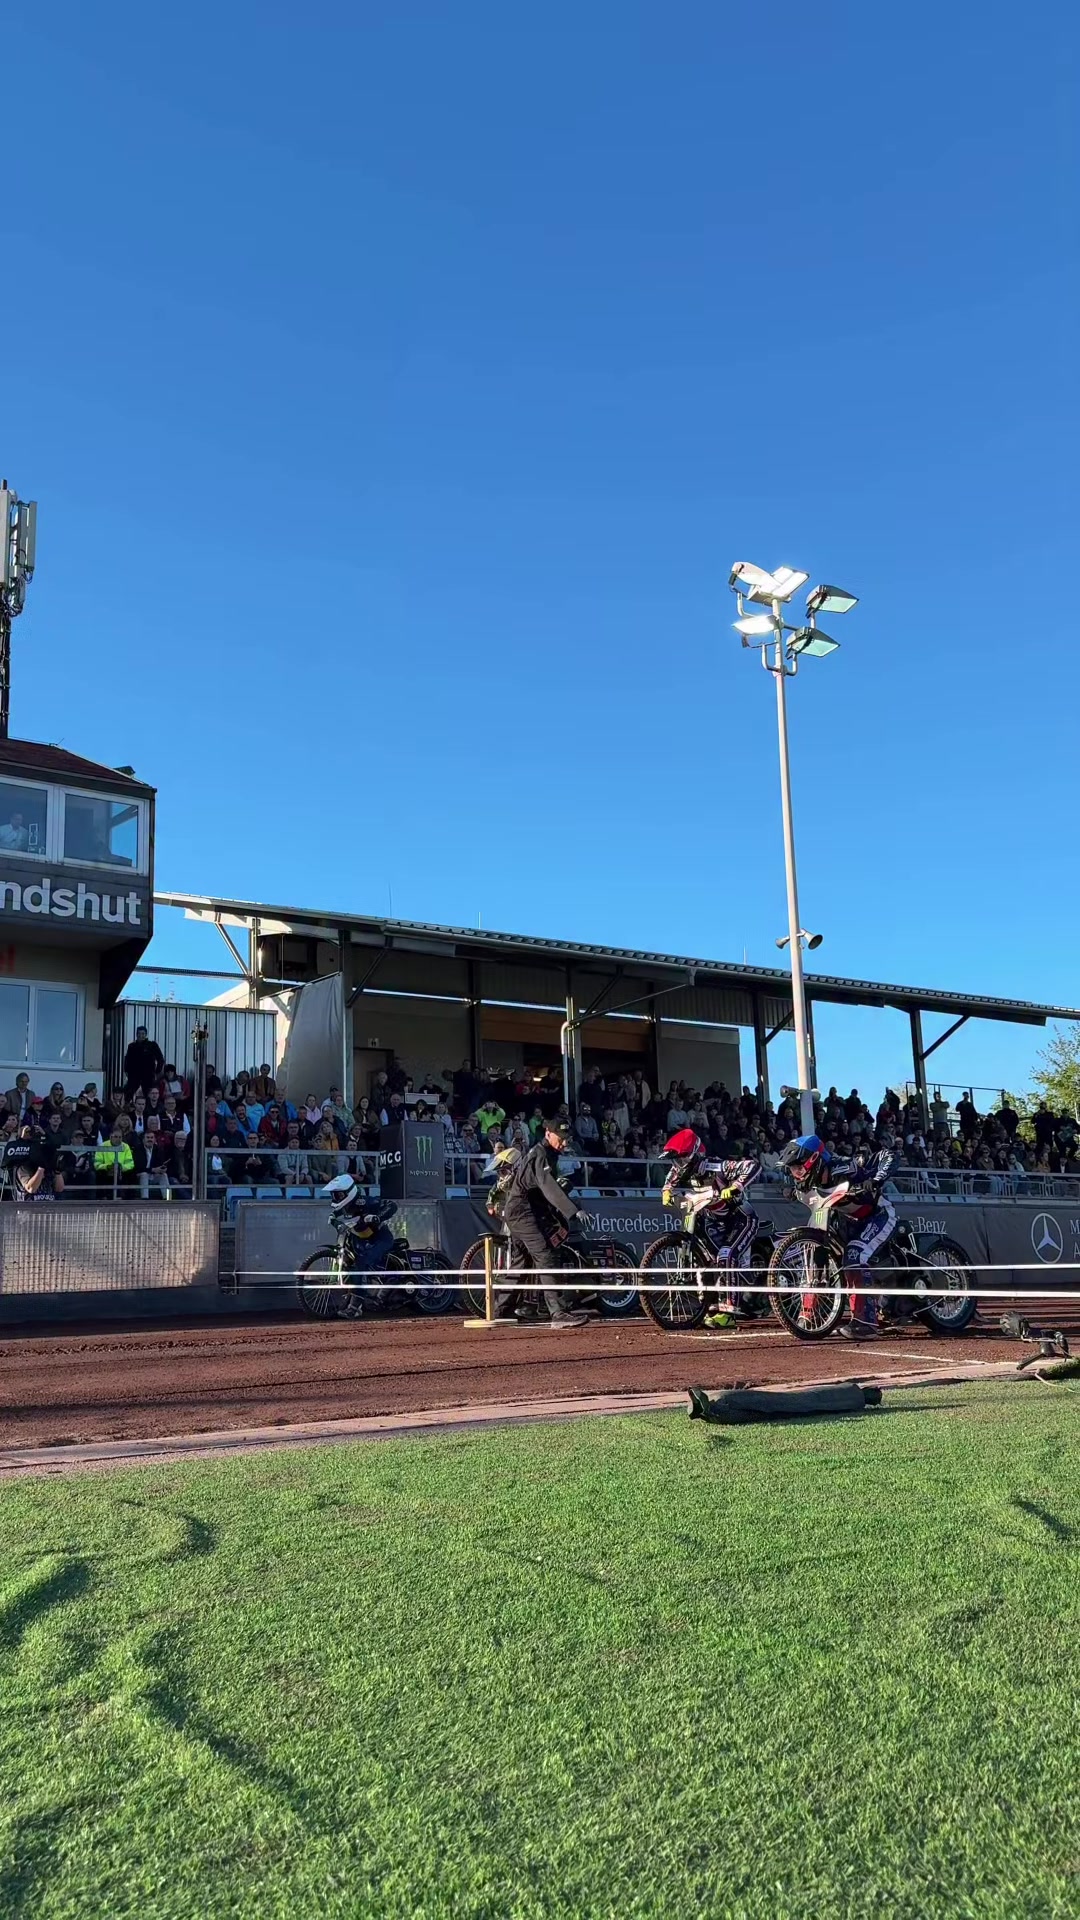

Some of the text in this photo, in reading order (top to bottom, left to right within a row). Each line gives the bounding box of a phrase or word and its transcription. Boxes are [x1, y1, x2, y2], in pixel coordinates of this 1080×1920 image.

[0, 878, 142, 925] ndshut
[380, 1151, 401, 1165] MCG
[586, 1213, 682, 1233] Mercedes-Be
